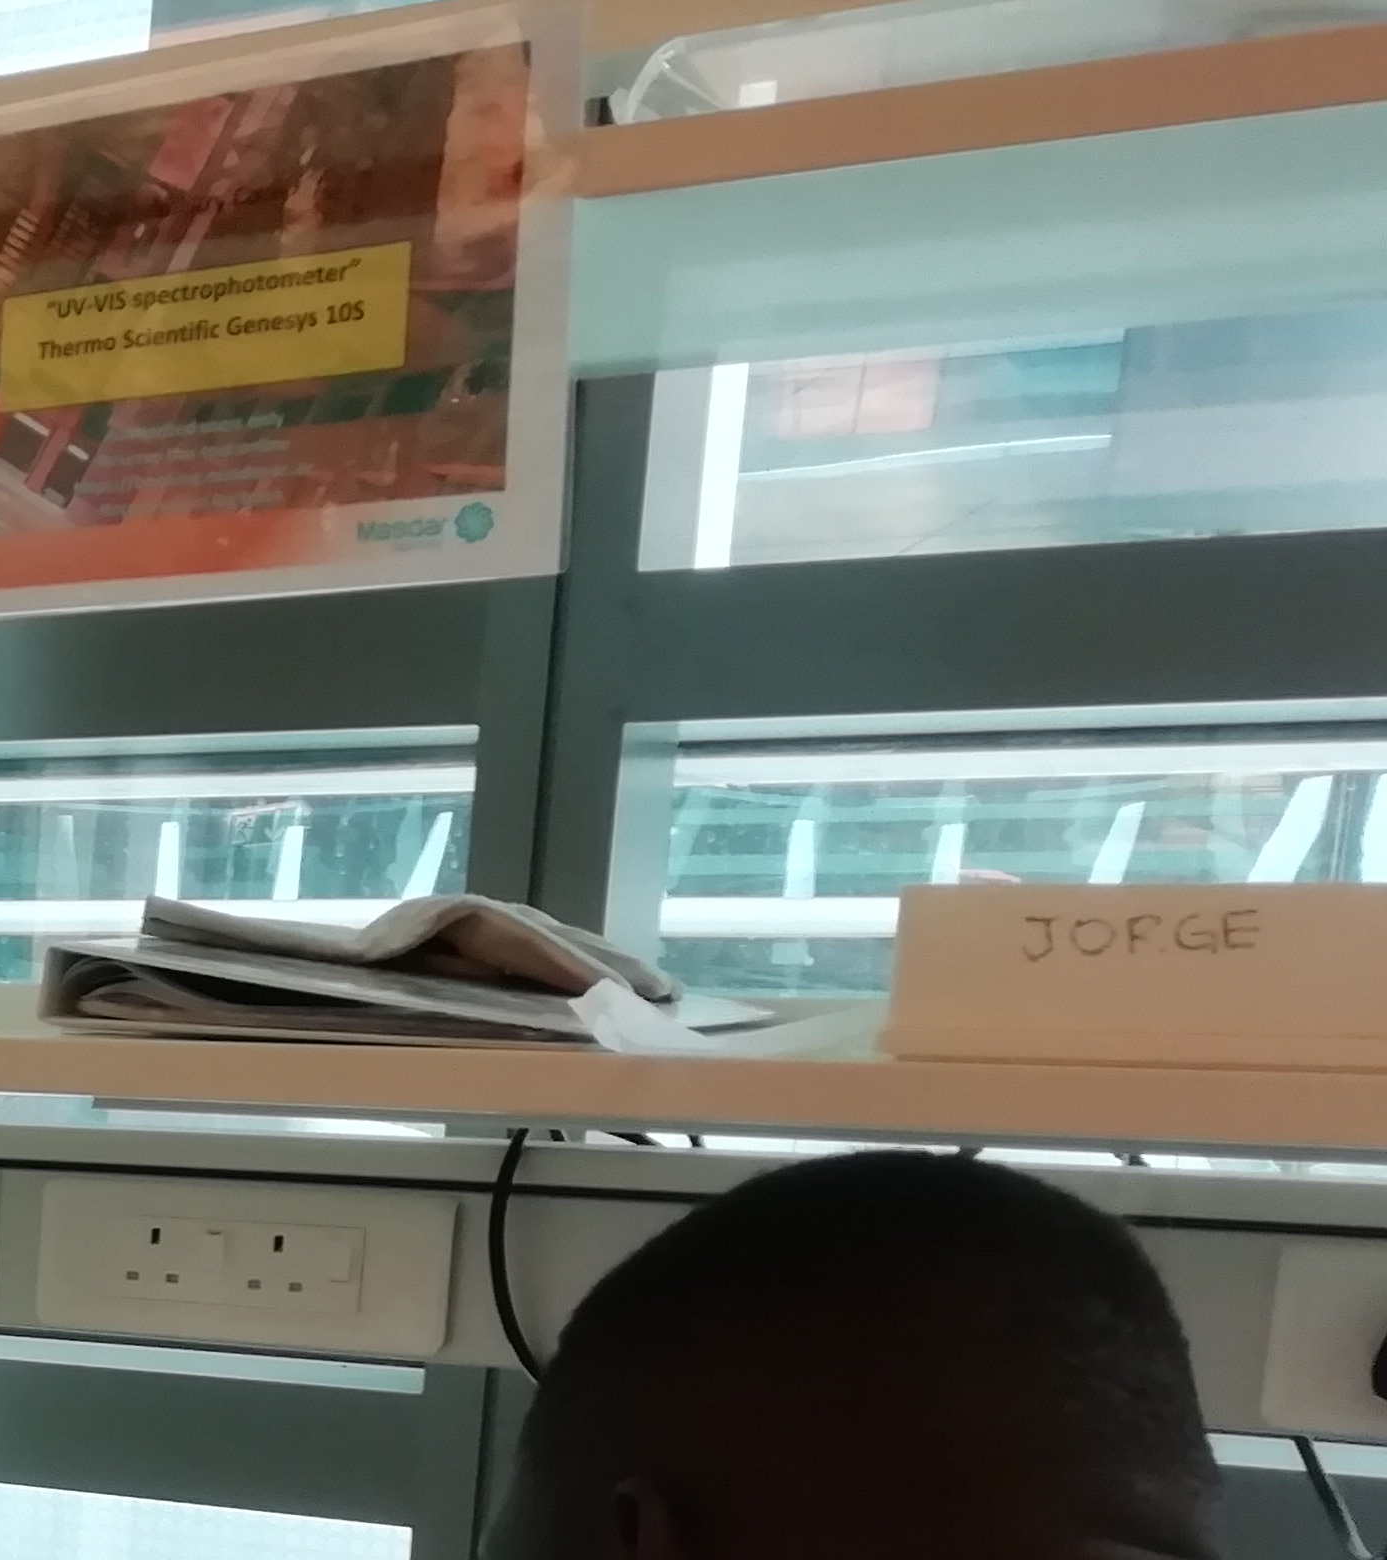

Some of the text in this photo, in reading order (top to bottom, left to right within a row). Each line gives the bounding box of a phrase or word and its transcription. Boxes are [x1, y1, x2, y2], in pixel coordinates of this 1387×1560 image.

[38, 300, 366, 361] Thermo Scientific Genesys 10S
